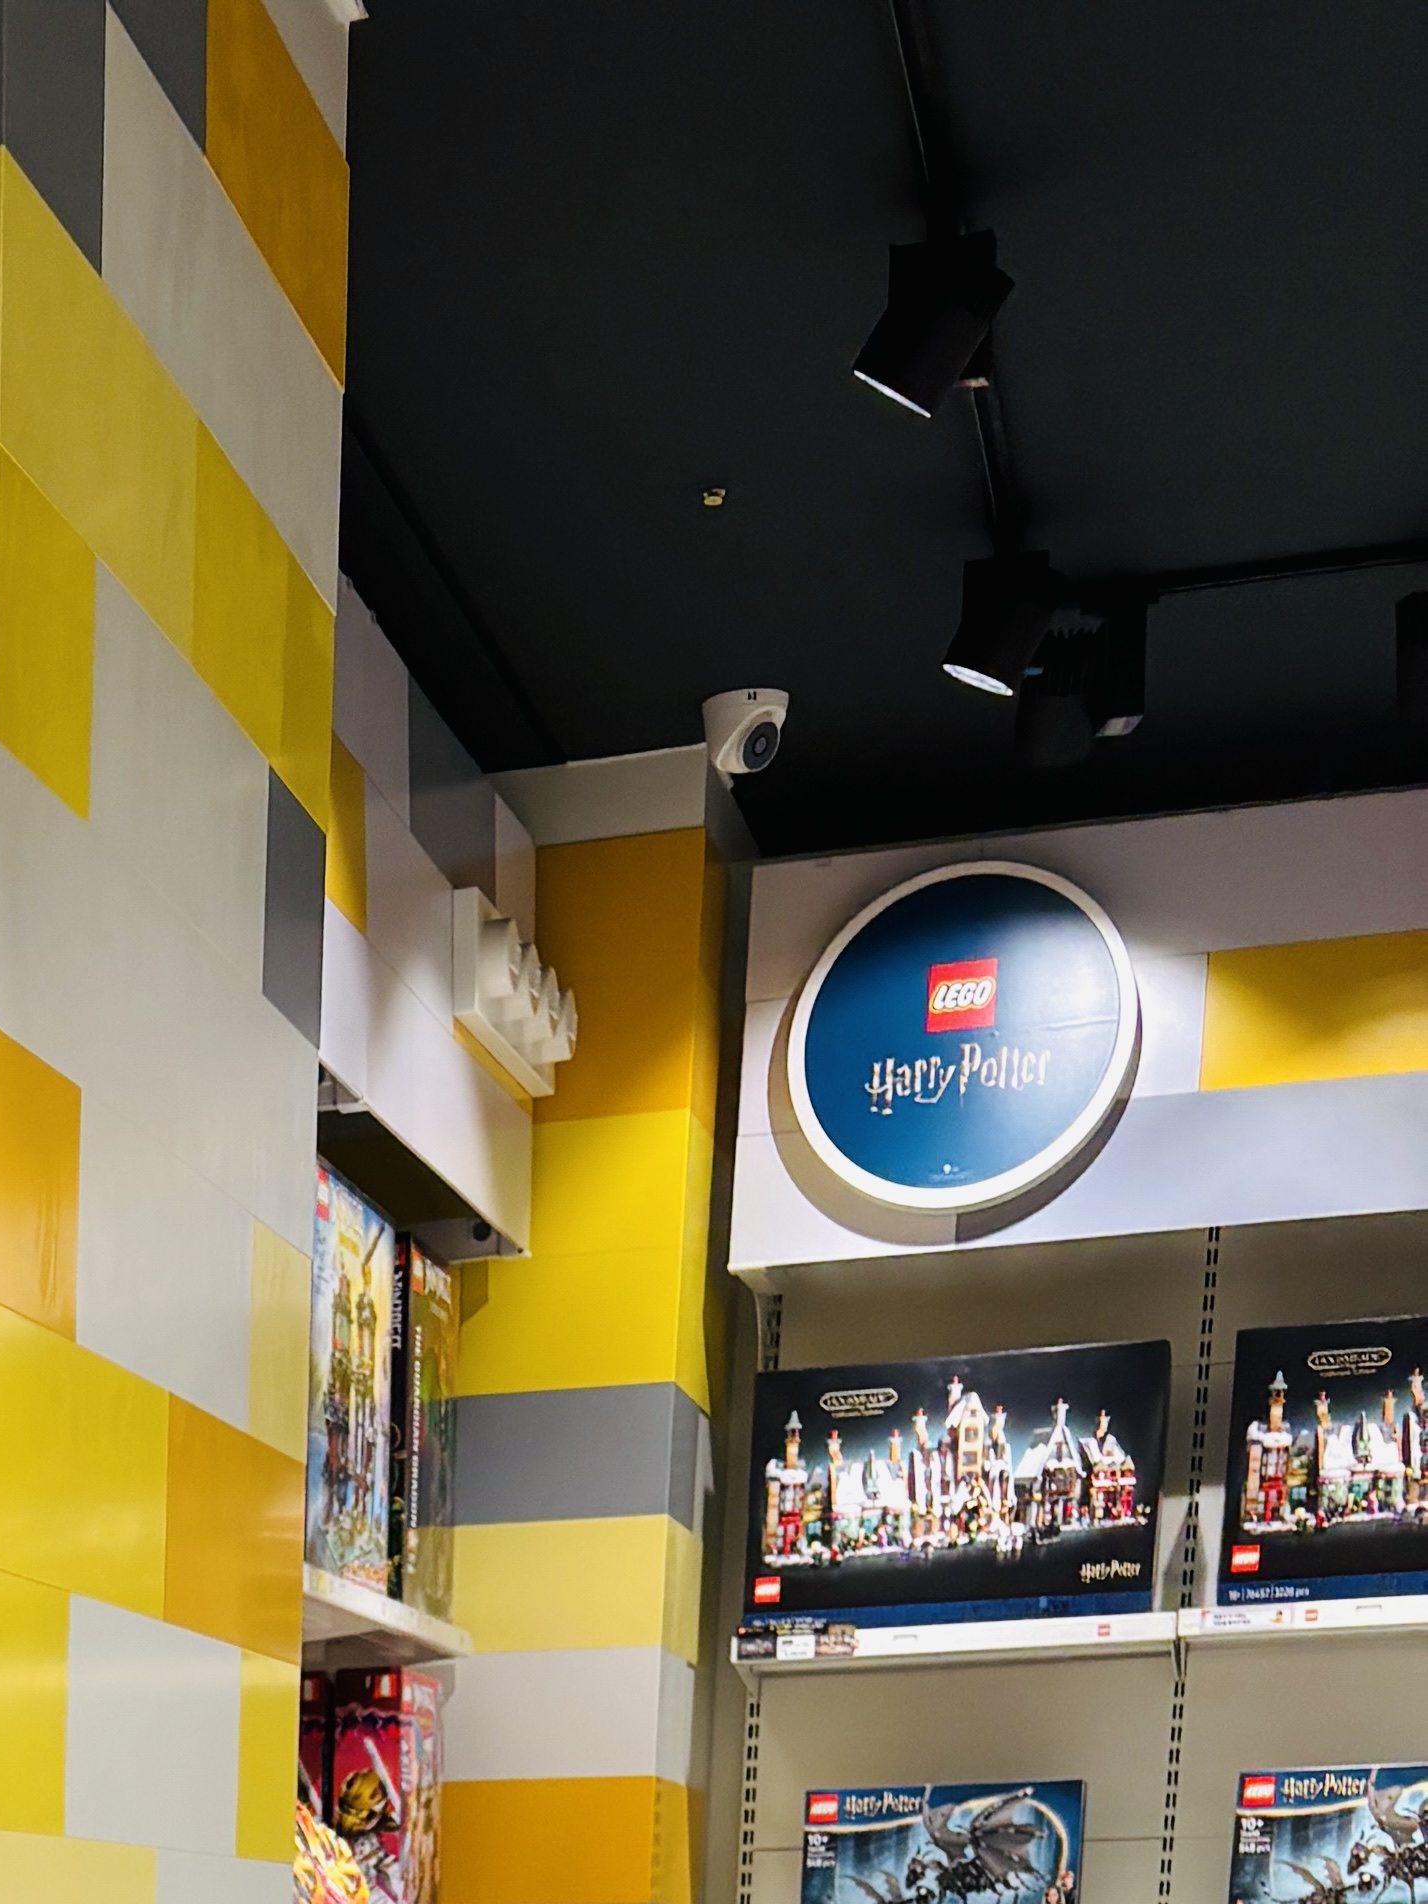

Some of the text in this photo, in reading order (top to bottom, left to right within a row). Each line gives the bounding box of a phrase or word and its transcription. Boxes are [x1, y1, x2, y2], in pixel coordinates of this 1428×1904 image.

[927, 978, 999, 1014] LEGO
[864, 1042, 1053, 1118] Harry Potter
